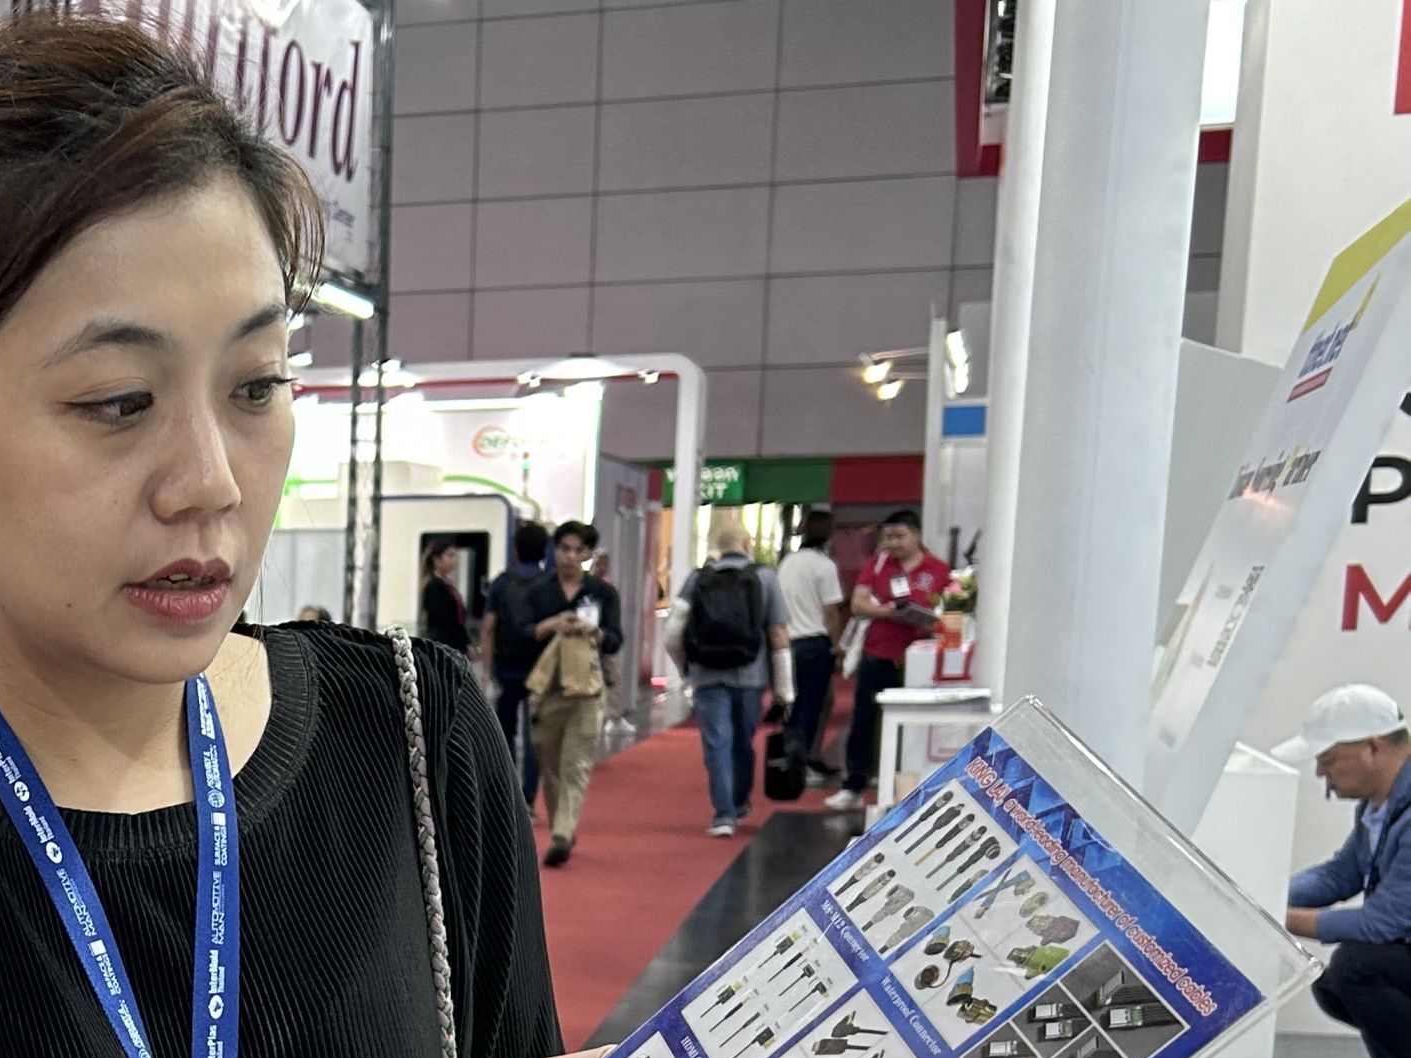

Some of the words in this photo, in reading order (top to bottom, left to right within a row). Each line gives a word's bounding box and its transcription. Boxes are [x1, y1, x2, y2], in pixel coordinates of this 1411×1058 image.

[23, 805, 47, 843] InterMold
[220, 828, 228, 866] COATINGS
[56, 869, 93, 936] AUTOMOTIVE
[211, 871, 222, 943] AUTOMOTIVE
[965, 757, 997, 790] KING
[1010, 801, 1069, 866] world-leading
[1059, 853, 1123, 921] manufacturer
[1125, 921, 1184, 985] customized
[1175, 971, 1218, 1017] cables
[840, 925, 870, 963] Connector
[208, 949, 218, 994] InterMold
[878, 975, 914, 1019] Waterproof
[907, 1014, 943, 1057] Connector
[679, 1035, 698, 1058] HDMI
